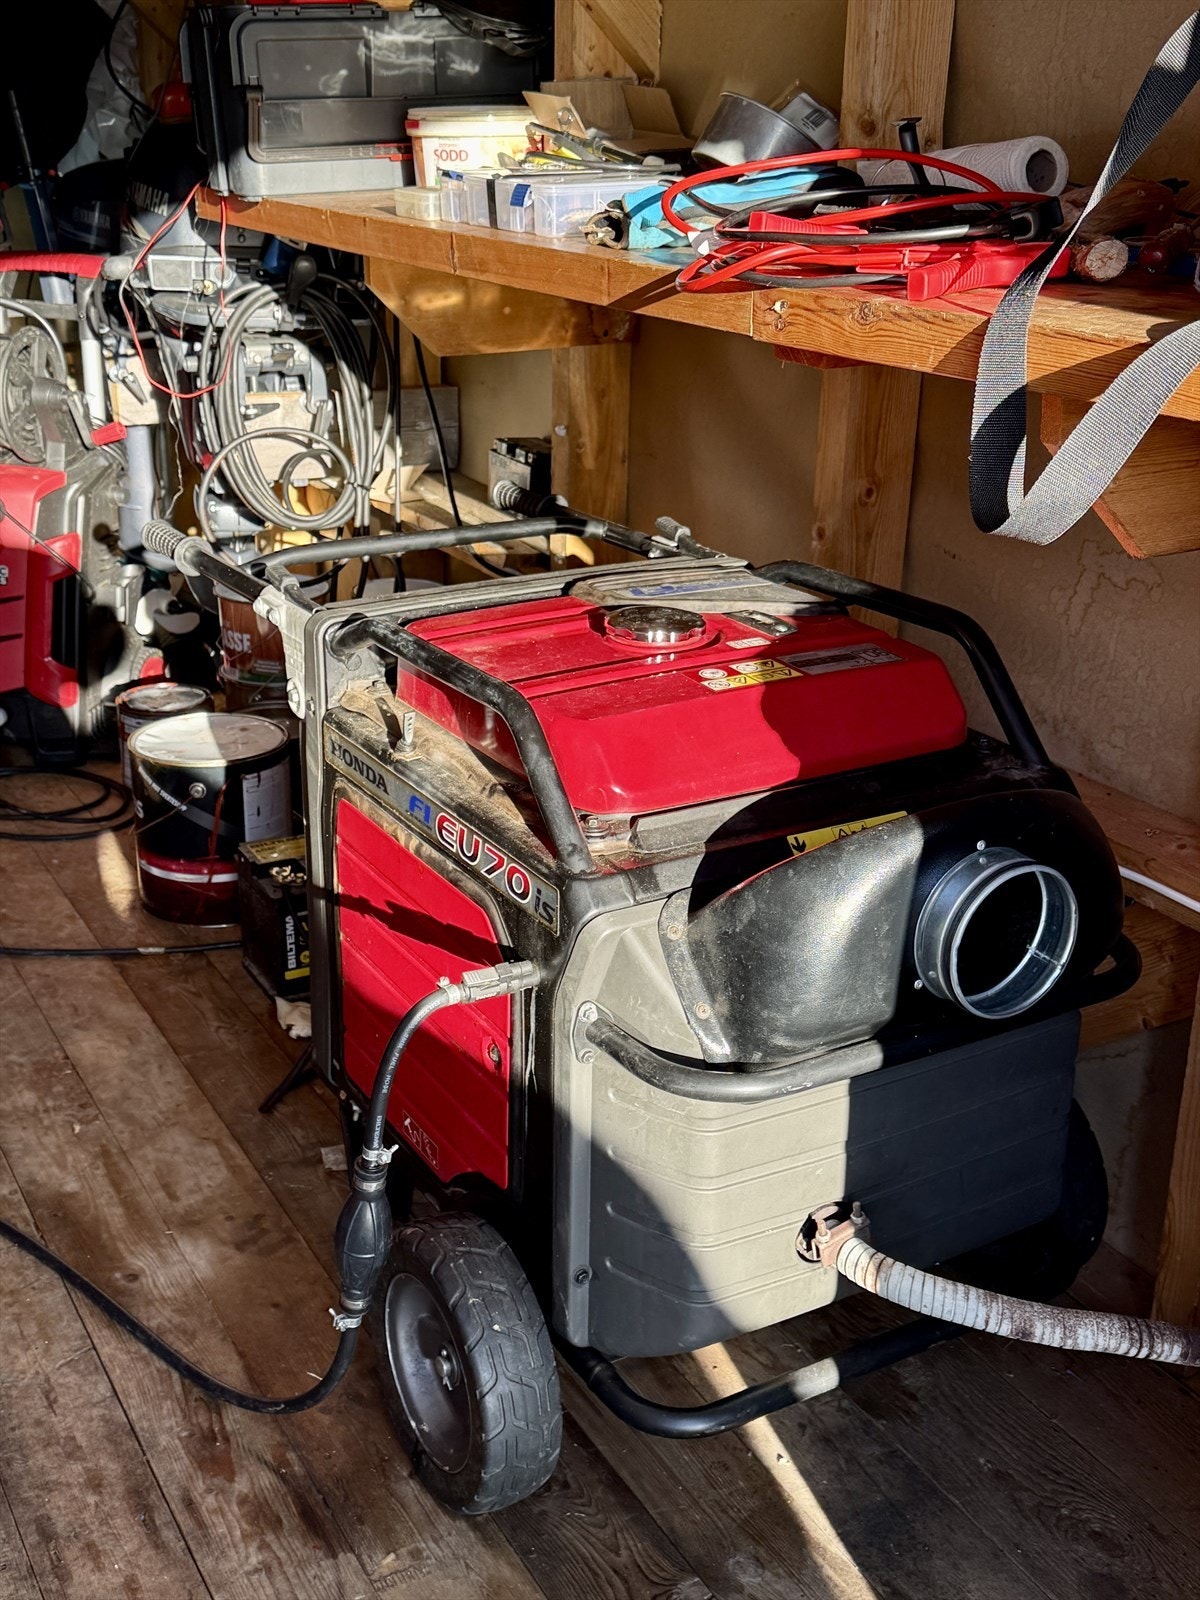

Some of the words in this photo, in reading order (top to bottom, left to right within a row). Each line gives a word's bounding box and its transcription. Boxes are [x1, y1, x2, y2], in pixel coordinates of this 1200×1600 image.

[433, 149, 469, 162] SODD
[330, 738, 389, 796] HONDA
[408, 795, 432, 825] FI
[284, 915, 297, 969] BILTEMA
